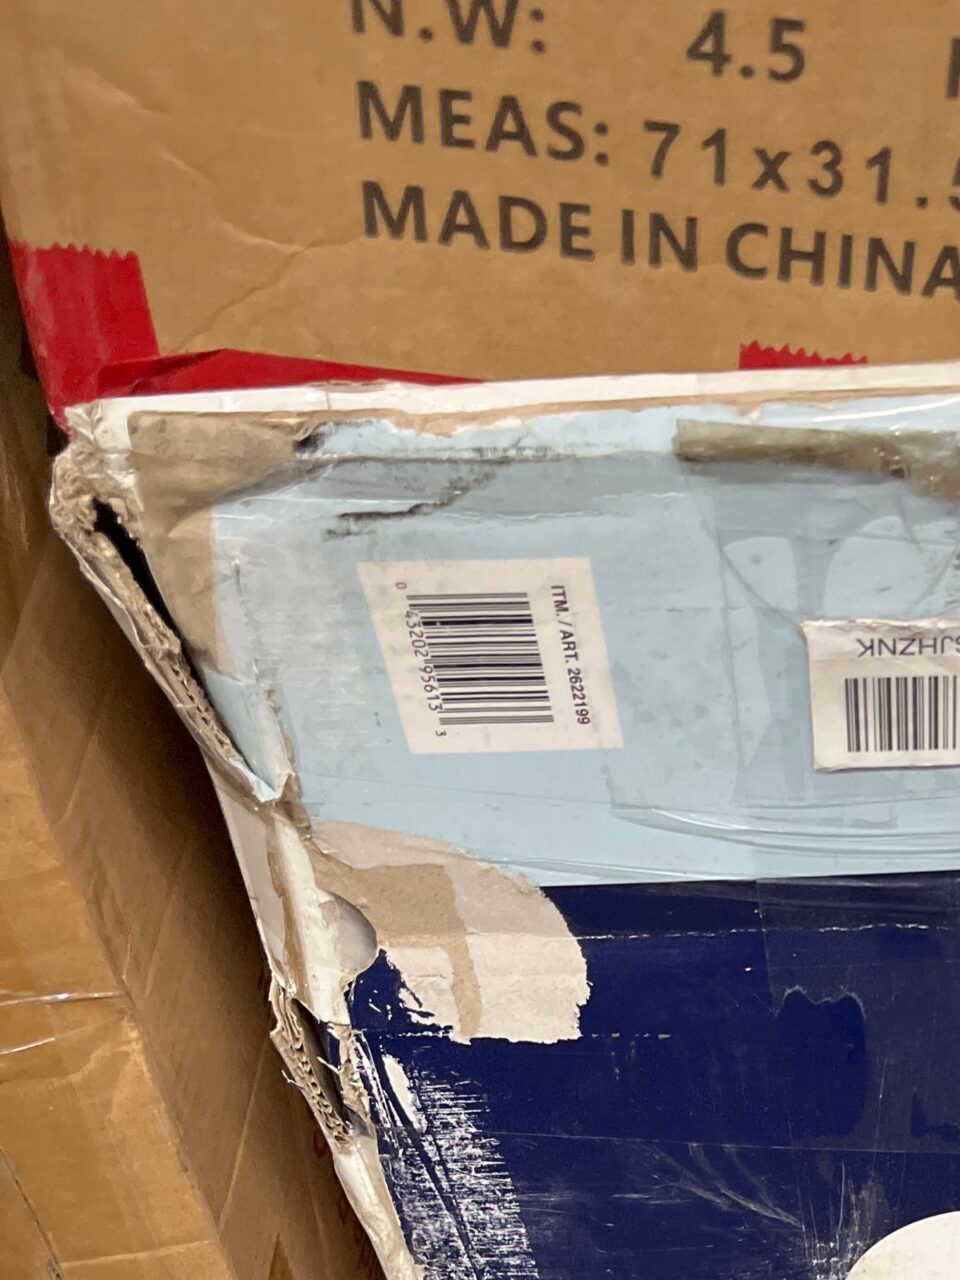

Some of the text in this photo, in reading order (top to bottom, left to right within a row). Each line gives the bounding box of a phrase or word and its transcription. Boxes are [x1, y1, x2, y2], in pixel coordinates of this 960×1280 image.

[351, 0, 549, 54] N.W:
[685, 8, 806, 83] 4.5
[355, 79, 612, 167] MEAS:
[360, 179, 596, 262] MADE
[620, 208, 699, 273] IN
[395, 582, 408, 591] 0
[550, 585, 568, 617] ITM.
[404, 609, 430, 658] 43202
[559, 629, 580, 664] ART.
[418, 664, 440, 713] 95613
[567, 667, 591, 726] 2622199
[434, 730, 448, 738] 3
